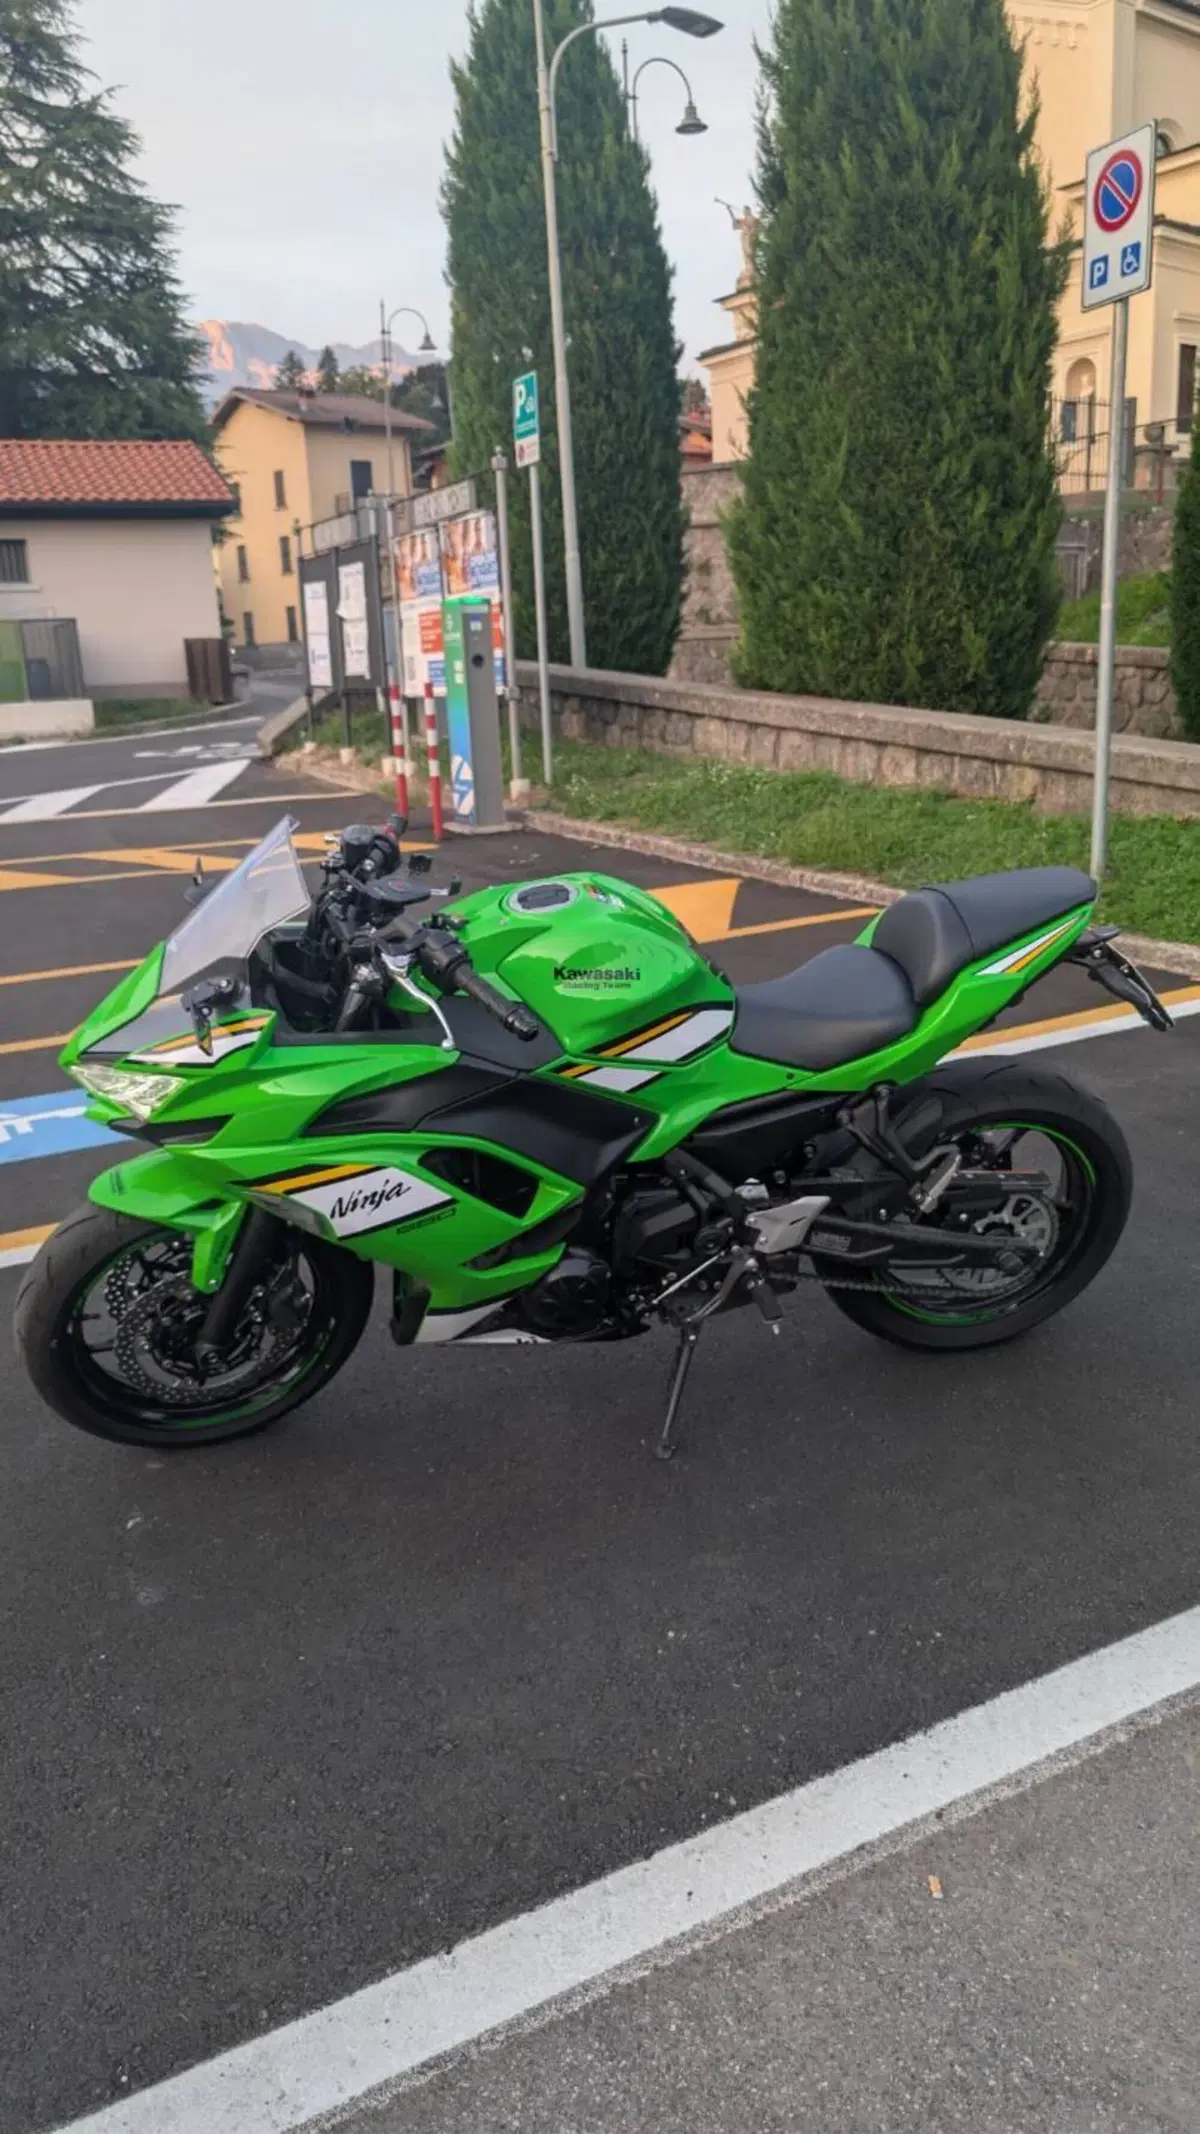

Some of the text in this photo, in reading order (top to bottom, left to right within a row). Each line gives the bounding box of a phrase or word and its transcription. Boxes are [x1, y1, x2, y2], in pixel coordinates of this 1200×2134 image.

[1093, 261, 1106, 286] P
[515, 383, 527, 418] P
[553, 966, 641, 981] Kawasaki
[329, 1179, 412, 1219] Ninja
